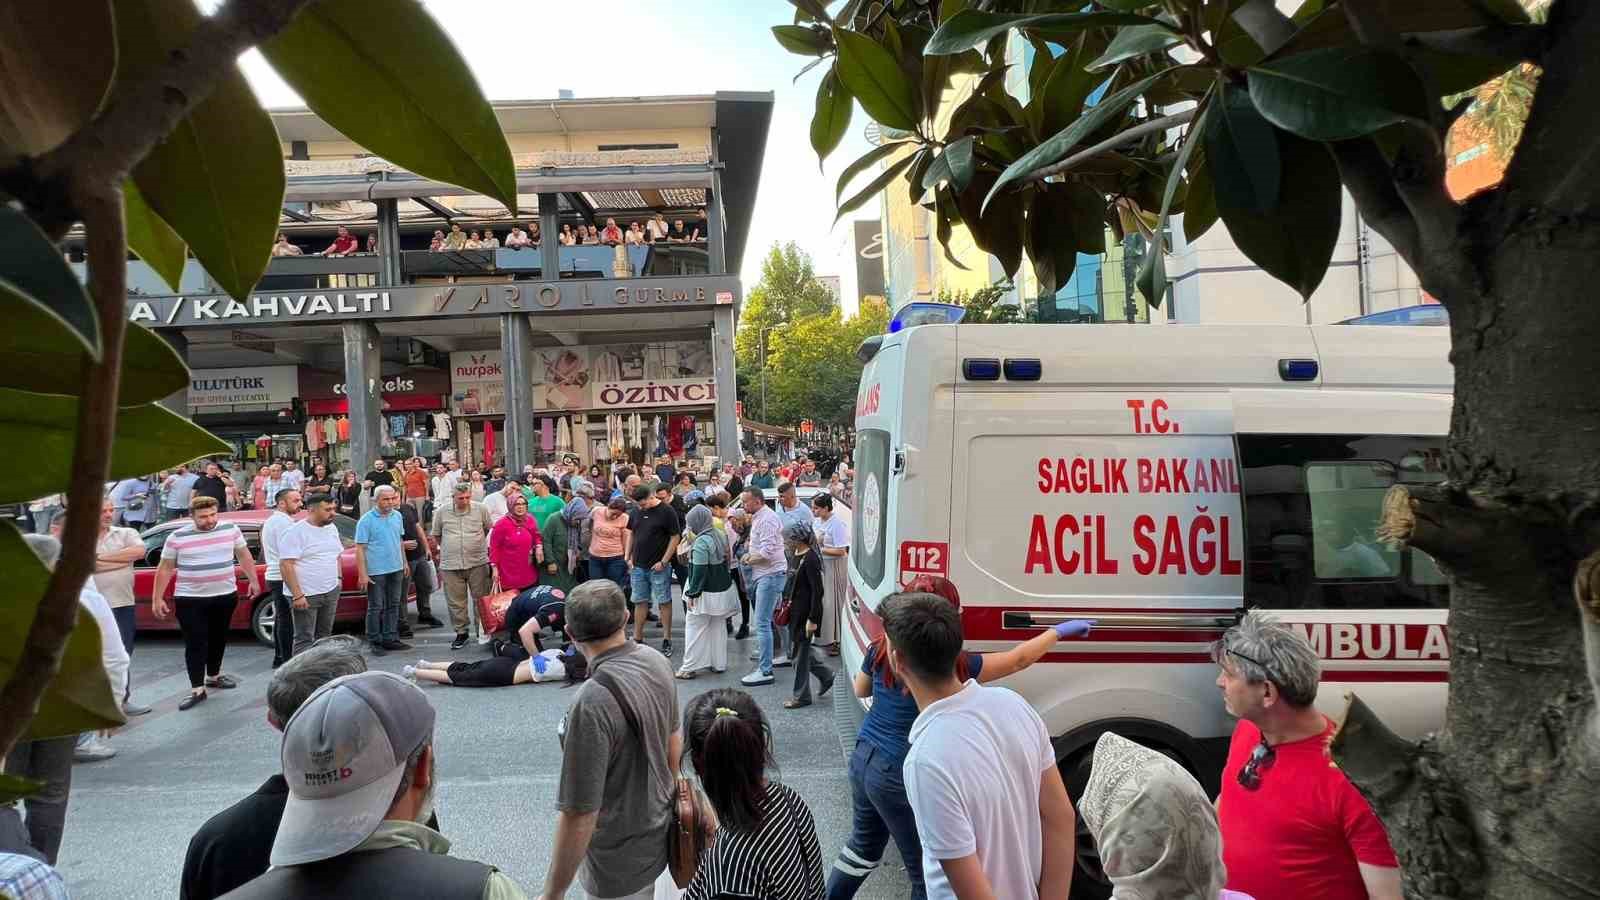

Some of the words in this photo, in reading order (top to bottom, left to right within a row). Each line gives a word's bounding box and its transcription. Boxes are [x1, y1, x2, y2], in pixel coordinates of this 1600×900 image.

[194, 291, 390, 319] KAHVALTI
[433, 284, 594, 312] VAROL
[456, 363, 502, 378] nurpak
[192, 377, 264, 391] ULUTÜRK
[1127, 399, 1179, 433] T.C.
[907, 546, 940, 569] 112
